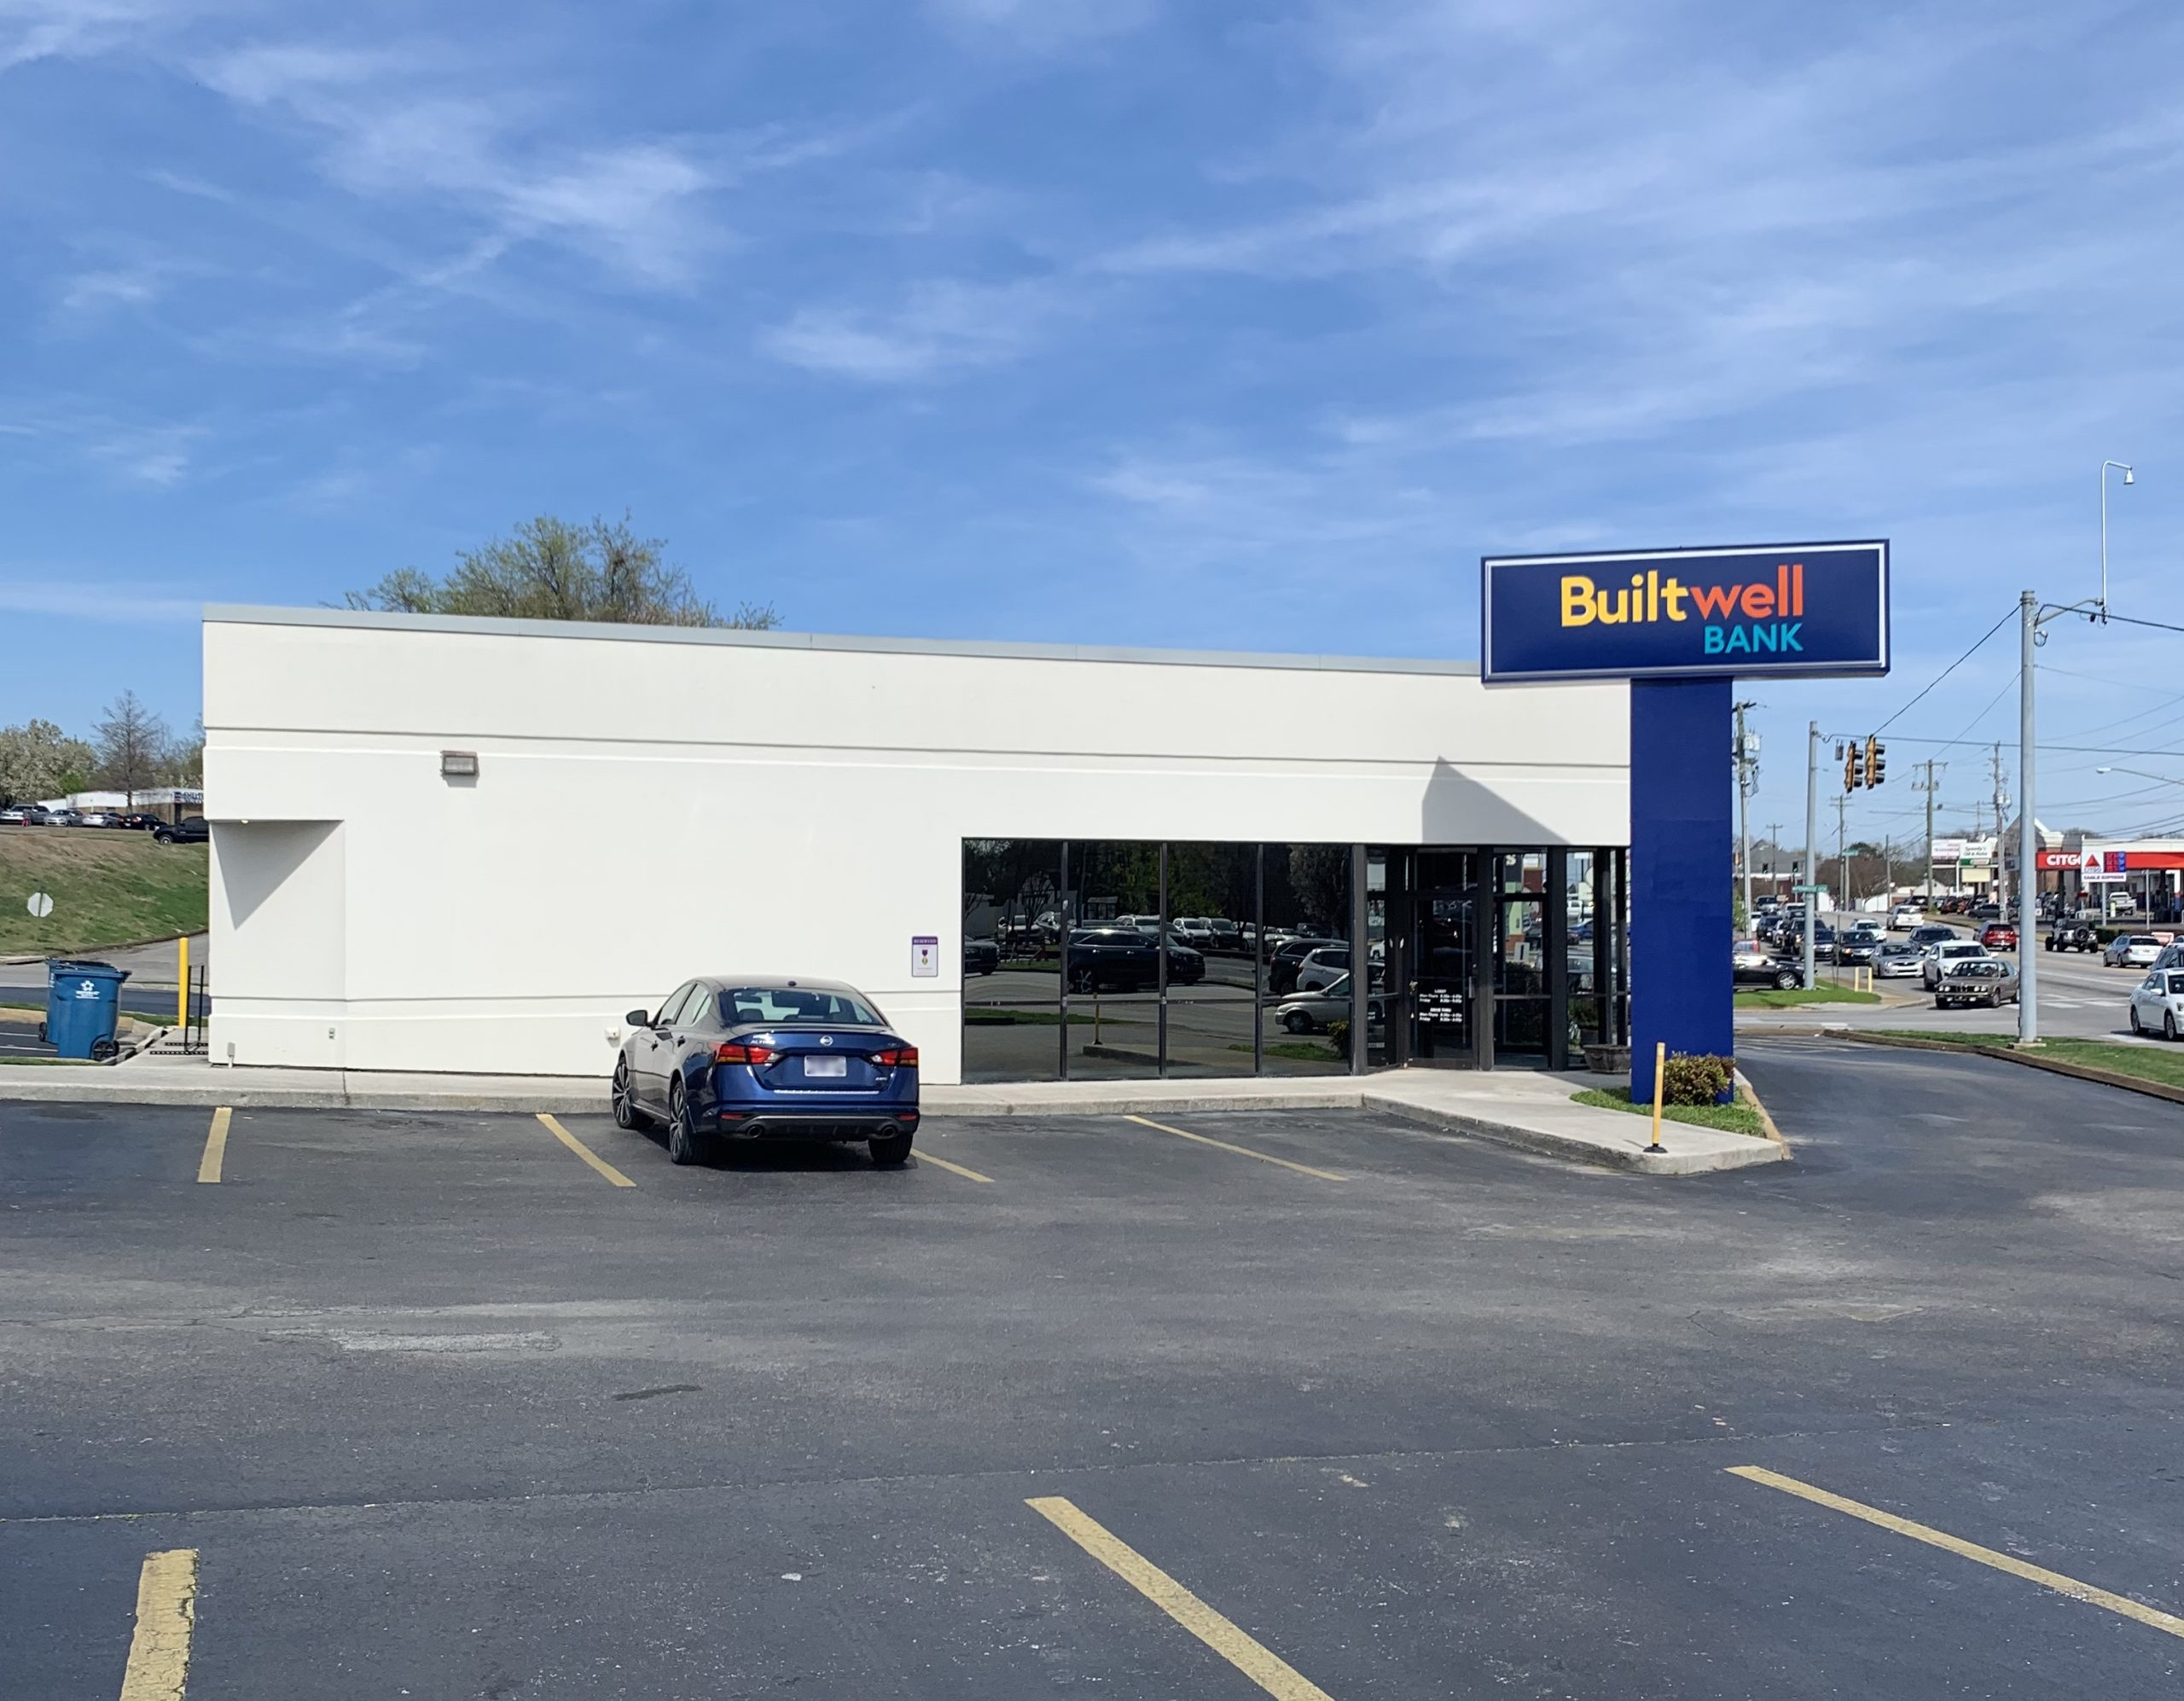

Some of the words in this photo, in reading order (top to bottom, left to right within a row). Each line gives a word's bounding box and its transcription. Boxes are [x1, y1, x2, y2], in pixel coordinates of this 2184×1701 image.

[1560, 564, 1804, 627] Builtwell
[1705, 623, 1804, 655] BANK
[2046, 854, 2081, 866] CITG
